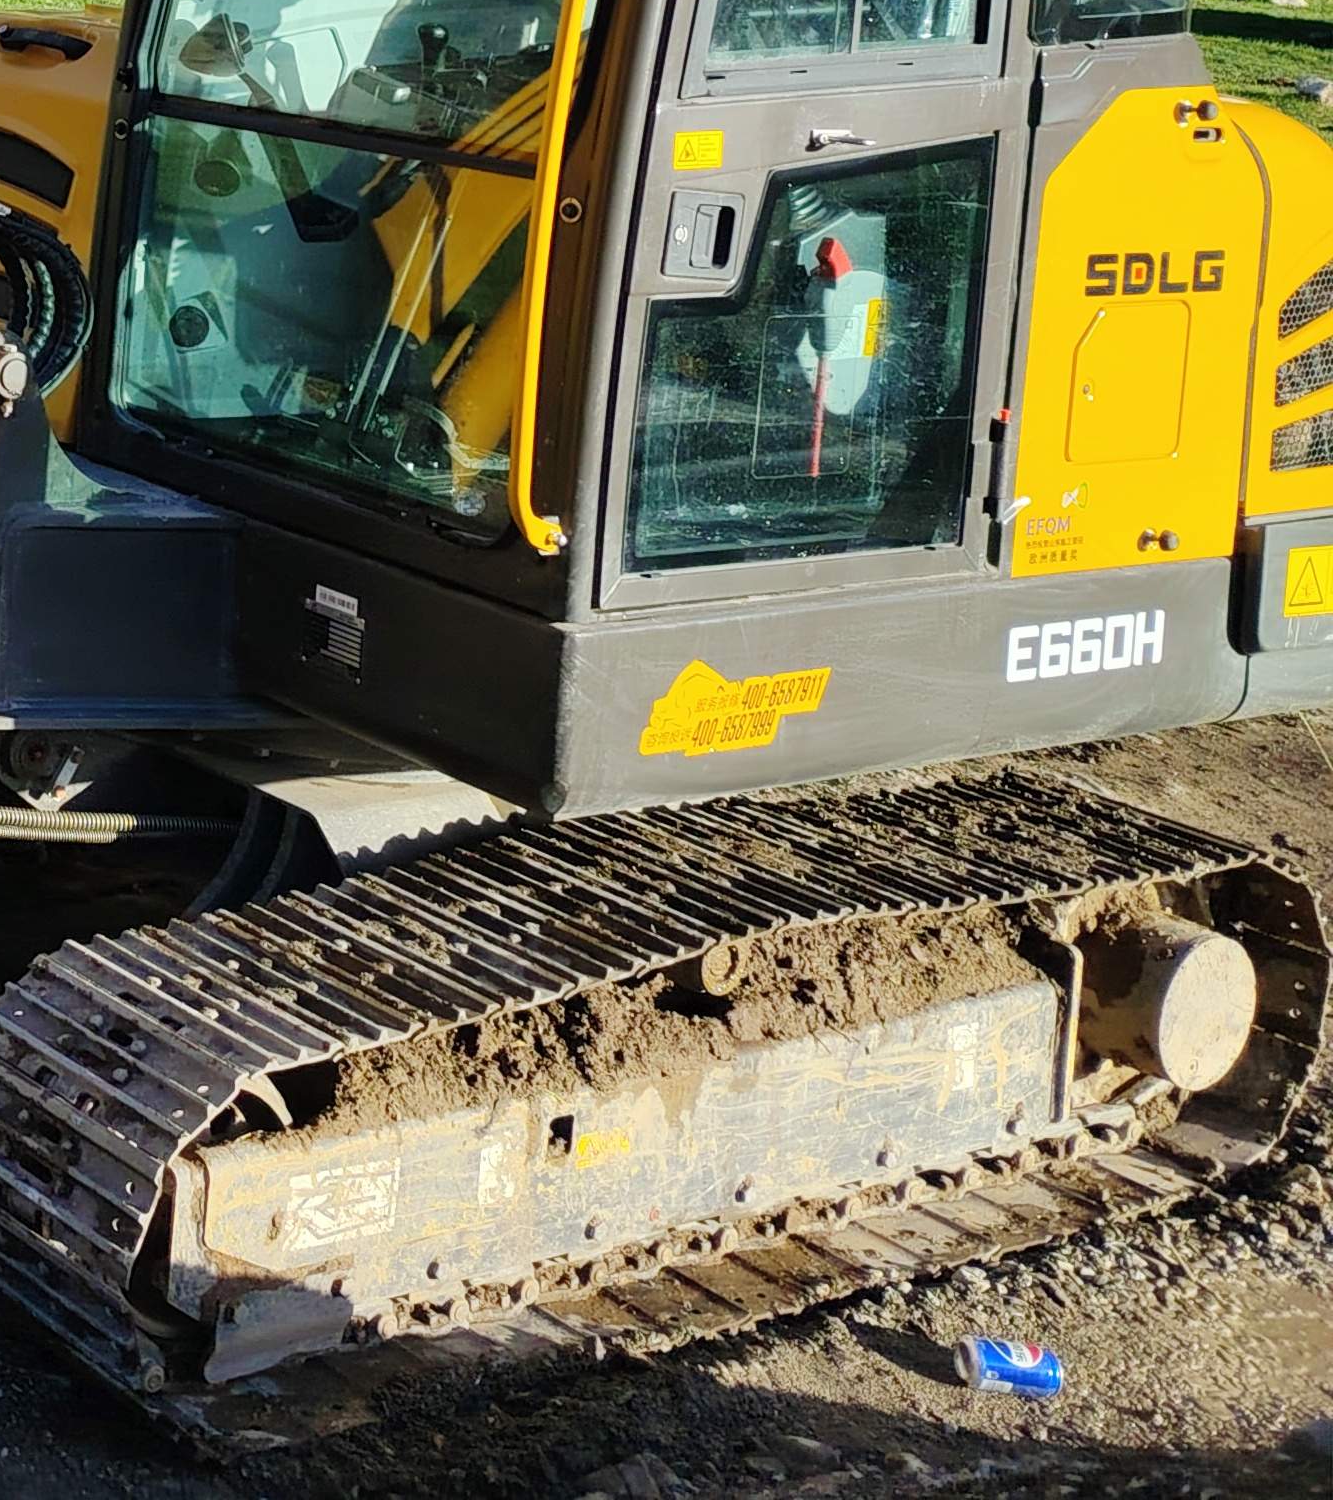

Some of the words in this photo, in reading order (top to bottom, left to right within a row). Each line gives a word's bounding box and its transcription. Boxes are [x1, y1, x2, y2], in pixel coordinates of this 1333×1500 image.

[1084, 250, 1226, 297] SDLG
[1026, 515, 1071, 536] EFQM
[1006, 609, 1166, 683] E660H
